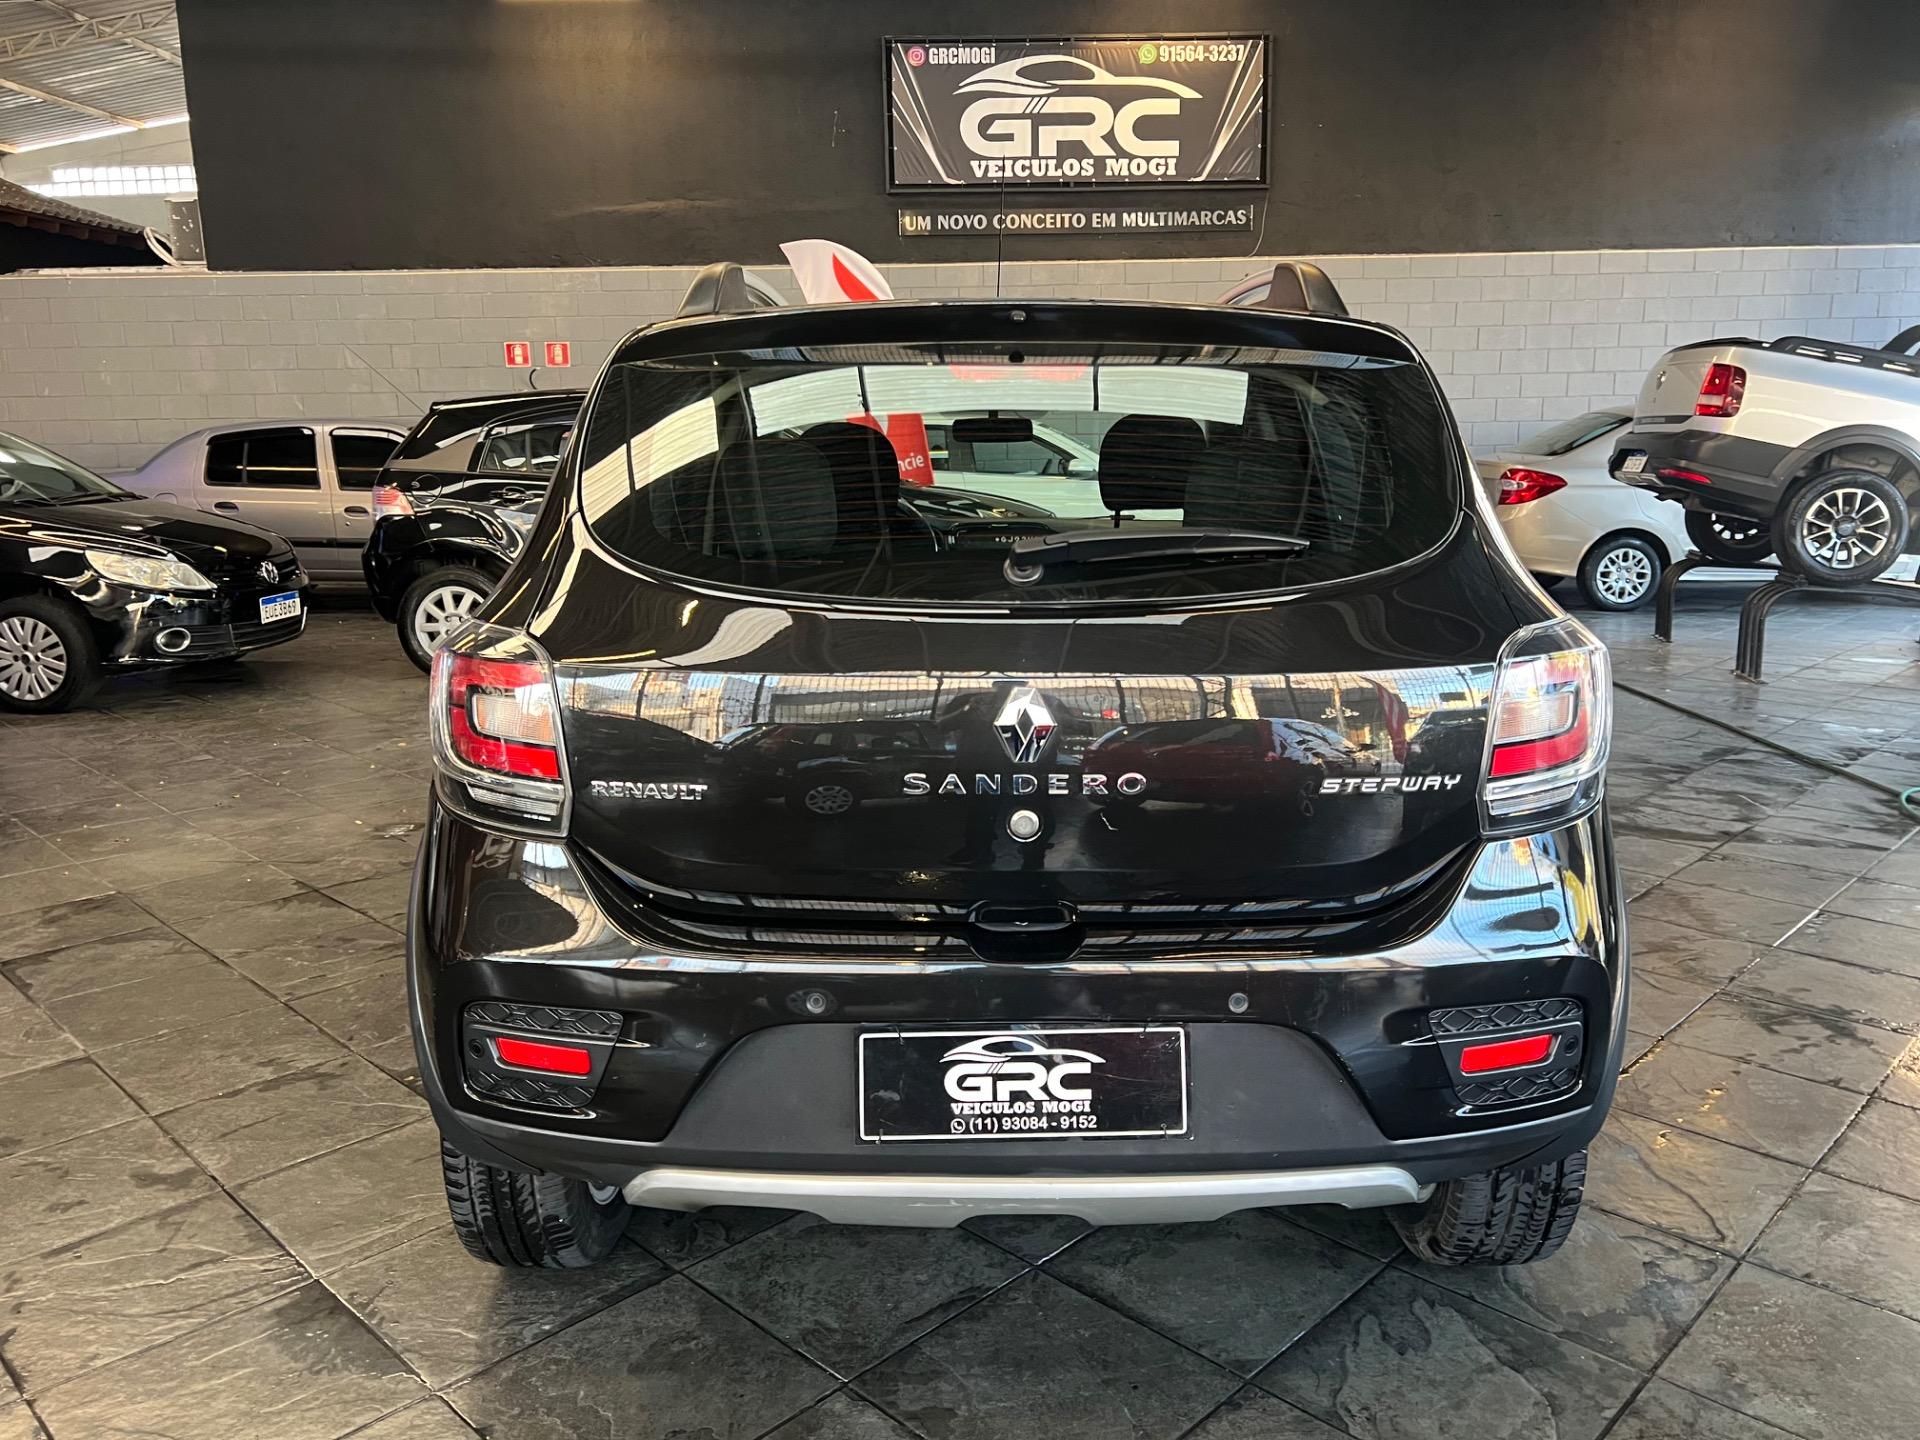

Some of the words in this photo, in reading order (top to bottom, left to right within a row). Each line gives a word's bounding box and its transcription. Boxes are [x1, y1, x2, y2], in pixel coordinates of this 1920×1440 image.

[928, 46, 996, 65] GRCMOGI
[1159, 44, 1245, 62] 91564-3237
[959, 96, 1180, 157] GRC
[970, 158, 1095, 178] VEICULOS
[1105, 157, 1177, 176] MOGI
[905, 216, 931, 231] UM
[937, 215, 987, 230] NOVO
[997, 212, 1086, 230] CONCEITO
[1092, 213, 1116, 228] EM
[1122, 209, 1247, 228] MULTIMARCAS
[590, 779, 709, 801] RENAULT
[903, 772, 1148, 796] SANDERO
[1320, 773, 1462, 794] STEPWAY
[944, 1061, 1092, 1102] GRC
[951, 1102, 1035, 1115] VEICULOS
[1042, 1100, 1091, 1113] MOGI
[969, 1117, 999, 1133] (11)
[1002, 1116, 1049, 1131] 93084
[1060, 1115, 1097, 1129] 9152
